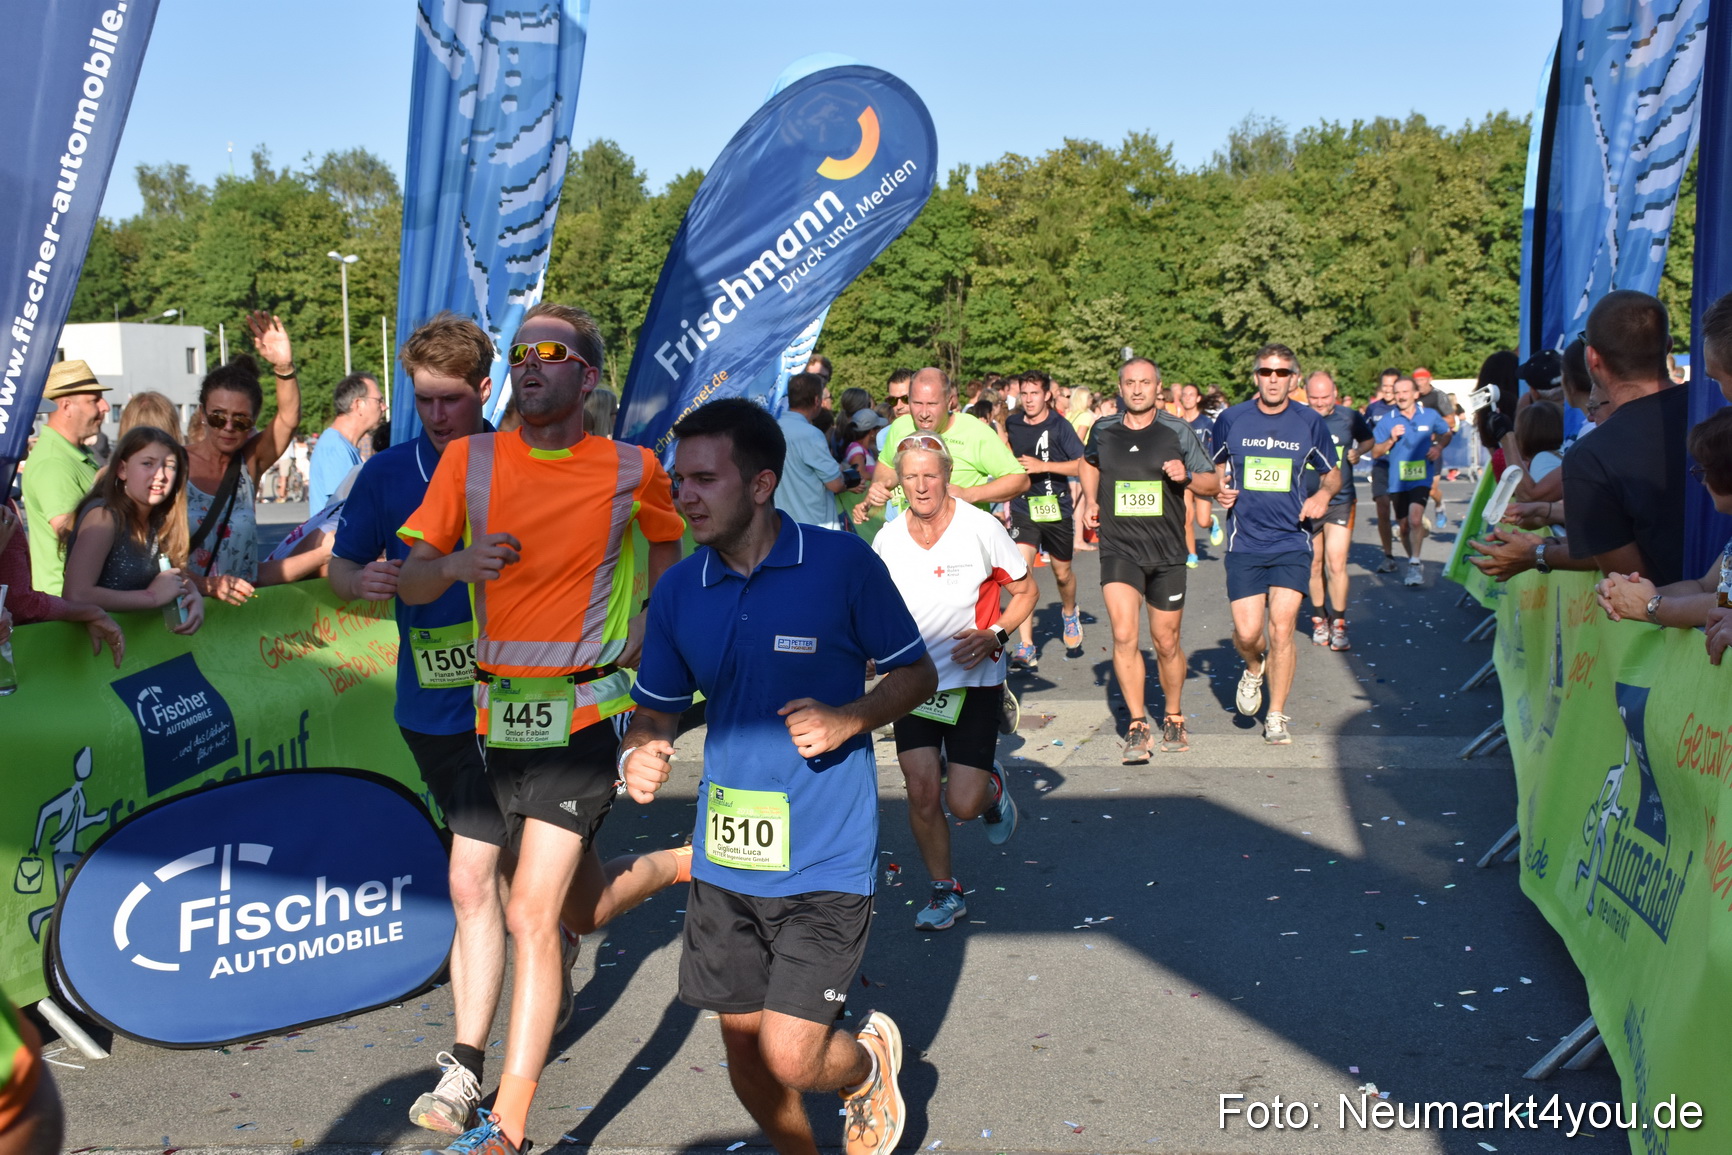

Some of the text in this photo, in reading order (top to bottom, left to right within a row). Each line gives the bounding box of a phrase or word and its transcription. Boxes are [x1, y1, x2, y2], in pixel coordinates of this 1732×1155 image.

[777, 158, 917, 293] Druck und Medien
[654, 190, 845, 381] Frischmann
[1242, 438, 1300, 451] EURO POLES
[1254, 469, 1280, 482] 520
[1034, 504, 1057, 514] 1598
[1121, 493, 1155, 506] 1389
[260, 607, 337, 669] Gesunde
[319, 651, 384, 696] laufen
[151, 691, 208, 727] Fischer
[166, 707, 213, 737] AUTOMOBILE
[503, 703, 552, 728] 445
[712, 813, 774, 848] 1510
[712, 849, 726, 858] PETTER
[717, 843, 762, 856] Gigliotti Luca
[1604, 807, 1693, 940] firmenlauf
[179, 874, 412, 953] Fischer
[1598, 897, 1632, 944] neumarkt
[209, 920, 404, 979] AUTOMOBILE
